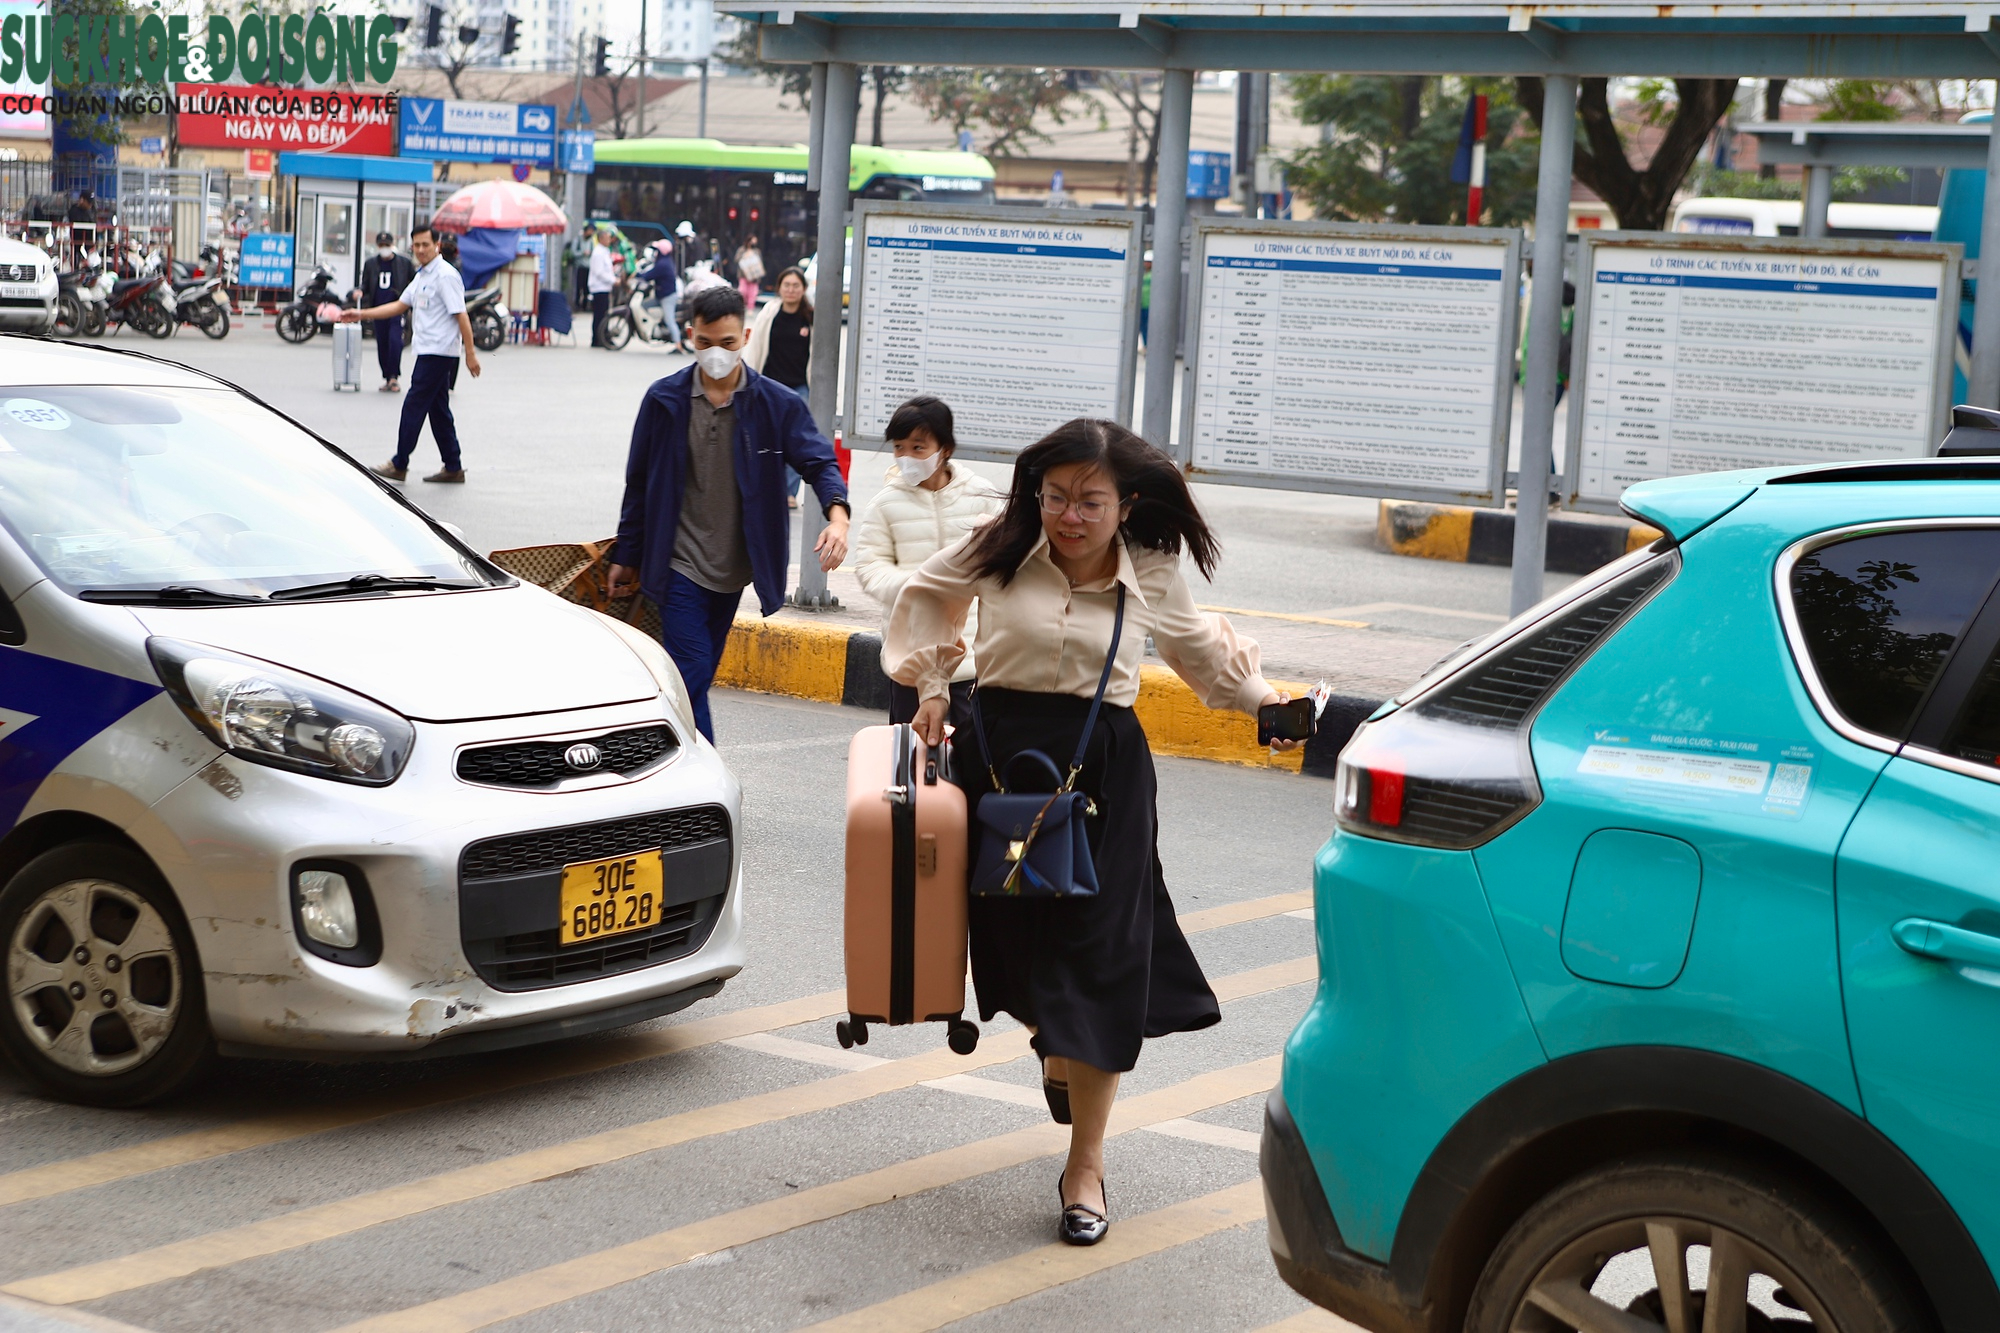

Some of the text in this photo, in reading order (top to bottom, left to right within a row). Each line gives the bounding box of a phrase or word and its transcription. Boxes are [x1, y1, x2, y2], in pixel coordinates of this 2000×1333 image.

[226, 117, 348, 145] NGÀY VÀ ĐÊM
[920, 225, 942, 235] TRÌNH
[944, 225, 960, 236] CÁC
[961, 225, 986, 237] TUYẾN
[987, 228, 998, 237] XE
[1000, 228, 1019, 238] BUÝT
[1053, 229, 1064, 240] KẾ
[1065, 230, 1082, 243] CẬN
[1268, 243, 1290, 253] TRÌNH
[1295, 243, 1311, 254] CÁC
[1315, 243, 1341, 256] TUYẾN
[1345, 247, 1356, 256] XE
[1359, 248, 1380, 258] BUÝT
[1419, 248, 1431, 259] KẾ
[1433, 250, 1452, 262] CẬN
[1666, 258, 1694, 269] TRÌNH
[1697, 259, 1716, 270] CÁC
[1721, 258, 1750, 272] TUYẾN
[1754, 263, 1768, 272] XE
[1771, 263, 1795, 273] BUÝT
[1841, 264, 1854, 276] KẾ
[1858, 268, 1879, 279] CẬN
[379, 271, 392, 289] U
[1719, 740, 1736, 749] TAXI
[1738, 742, 1759, 752] FARE
[570, 748, 598, 766] KIA
[592, 858, 637, 896] 30E
[573, 892, 653, 938] 688.28
